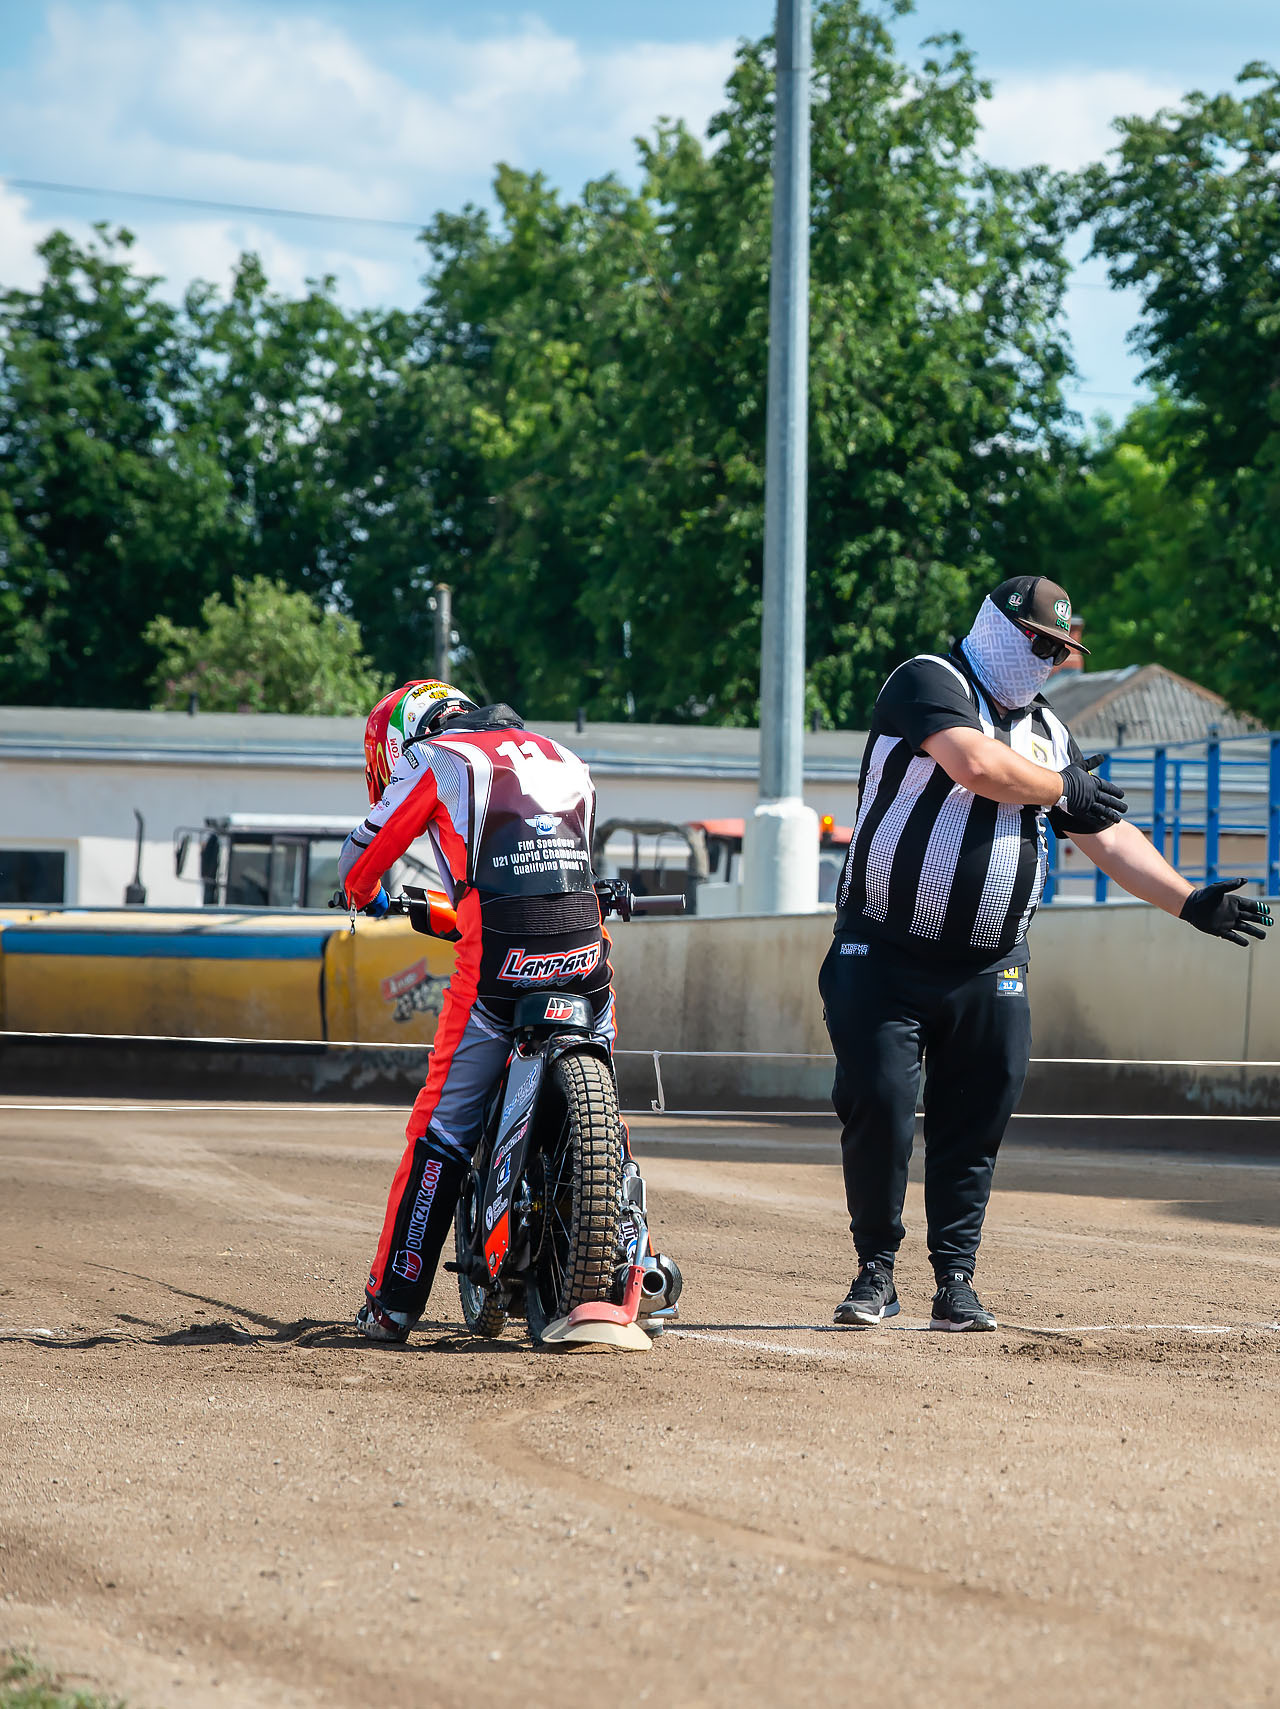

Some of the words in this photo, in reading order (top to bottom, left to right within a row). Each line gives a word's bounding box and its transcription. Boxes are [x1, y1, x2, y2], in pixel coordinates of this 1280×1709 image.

[517, 839, 535, 852] FIM
[536, 837, 575, 850] Speedway
[492, 855, 509, 868] U21
[510, 850, 541, 864] World
[542, 848, 589, 862] Championsh
[513, 860, 558, 876] Qualifying
[501, 944, 599, 978] LAMPART
[406, 1158, 443, 1250] DUNCZYK.COM
